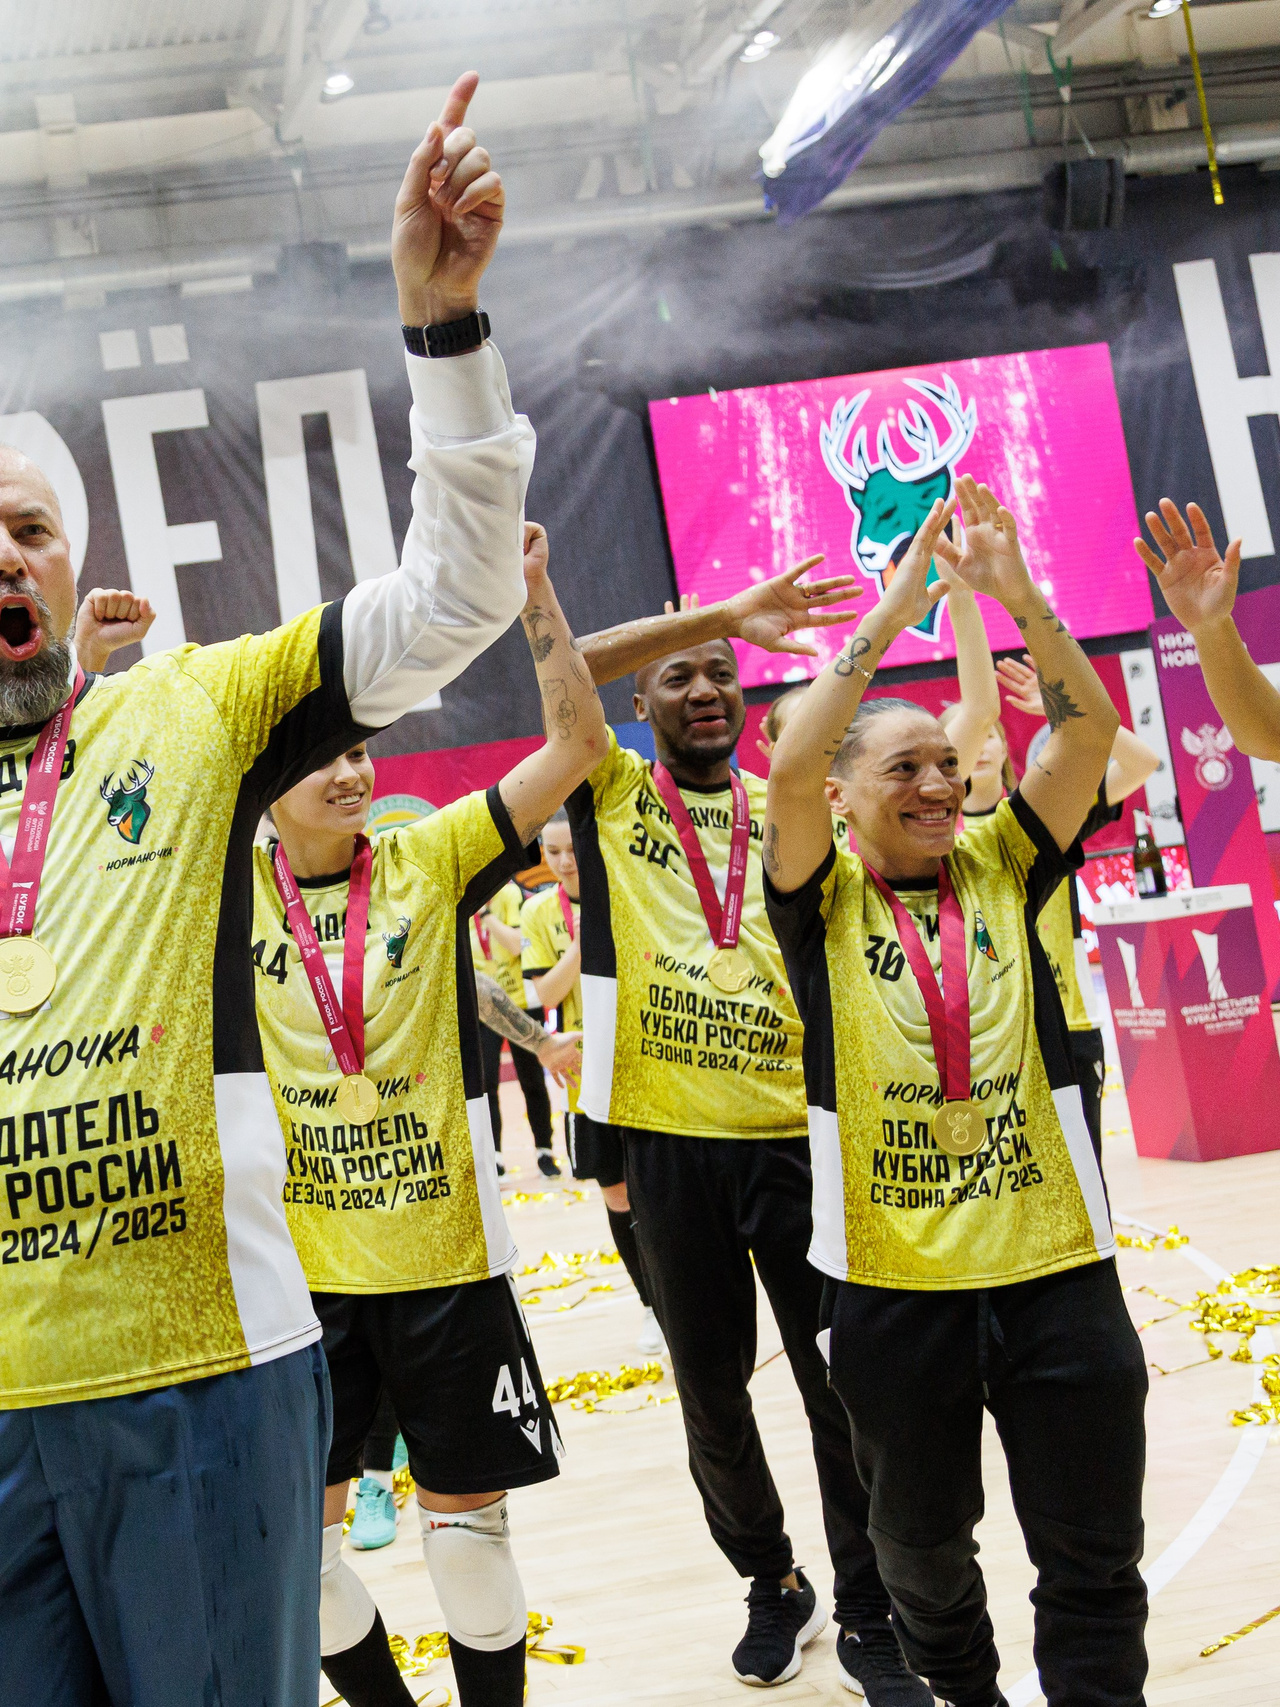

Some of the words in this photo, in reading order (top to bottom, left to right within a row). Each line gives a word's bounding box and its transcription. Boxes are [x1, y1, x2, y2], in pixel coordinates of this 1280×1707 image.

[43, 741, 58, 774] РОССИИ
[106, 847, 174, 872] НОРМАНОЧКА
[15, 893, 29, 924] КУБОК
[649, 983, 784, 1029] ОБЛАДАТЕЛЬ
[640, 1010, 698, 1045] КУБКА
[705, 1023, 788, 1055] РОССИИ
[641, 1038, 692, 1066] СЕЗОНА
[6, 1140, 184, 1220] РОССИИ
[342, 1141, 444, 1184] РОССИИ
[873, 1148, 950, 1183] КУБКА
[870, 1182, 945, 1209] СЕЗОНА
[492, 1356, 540, 1419] 44
